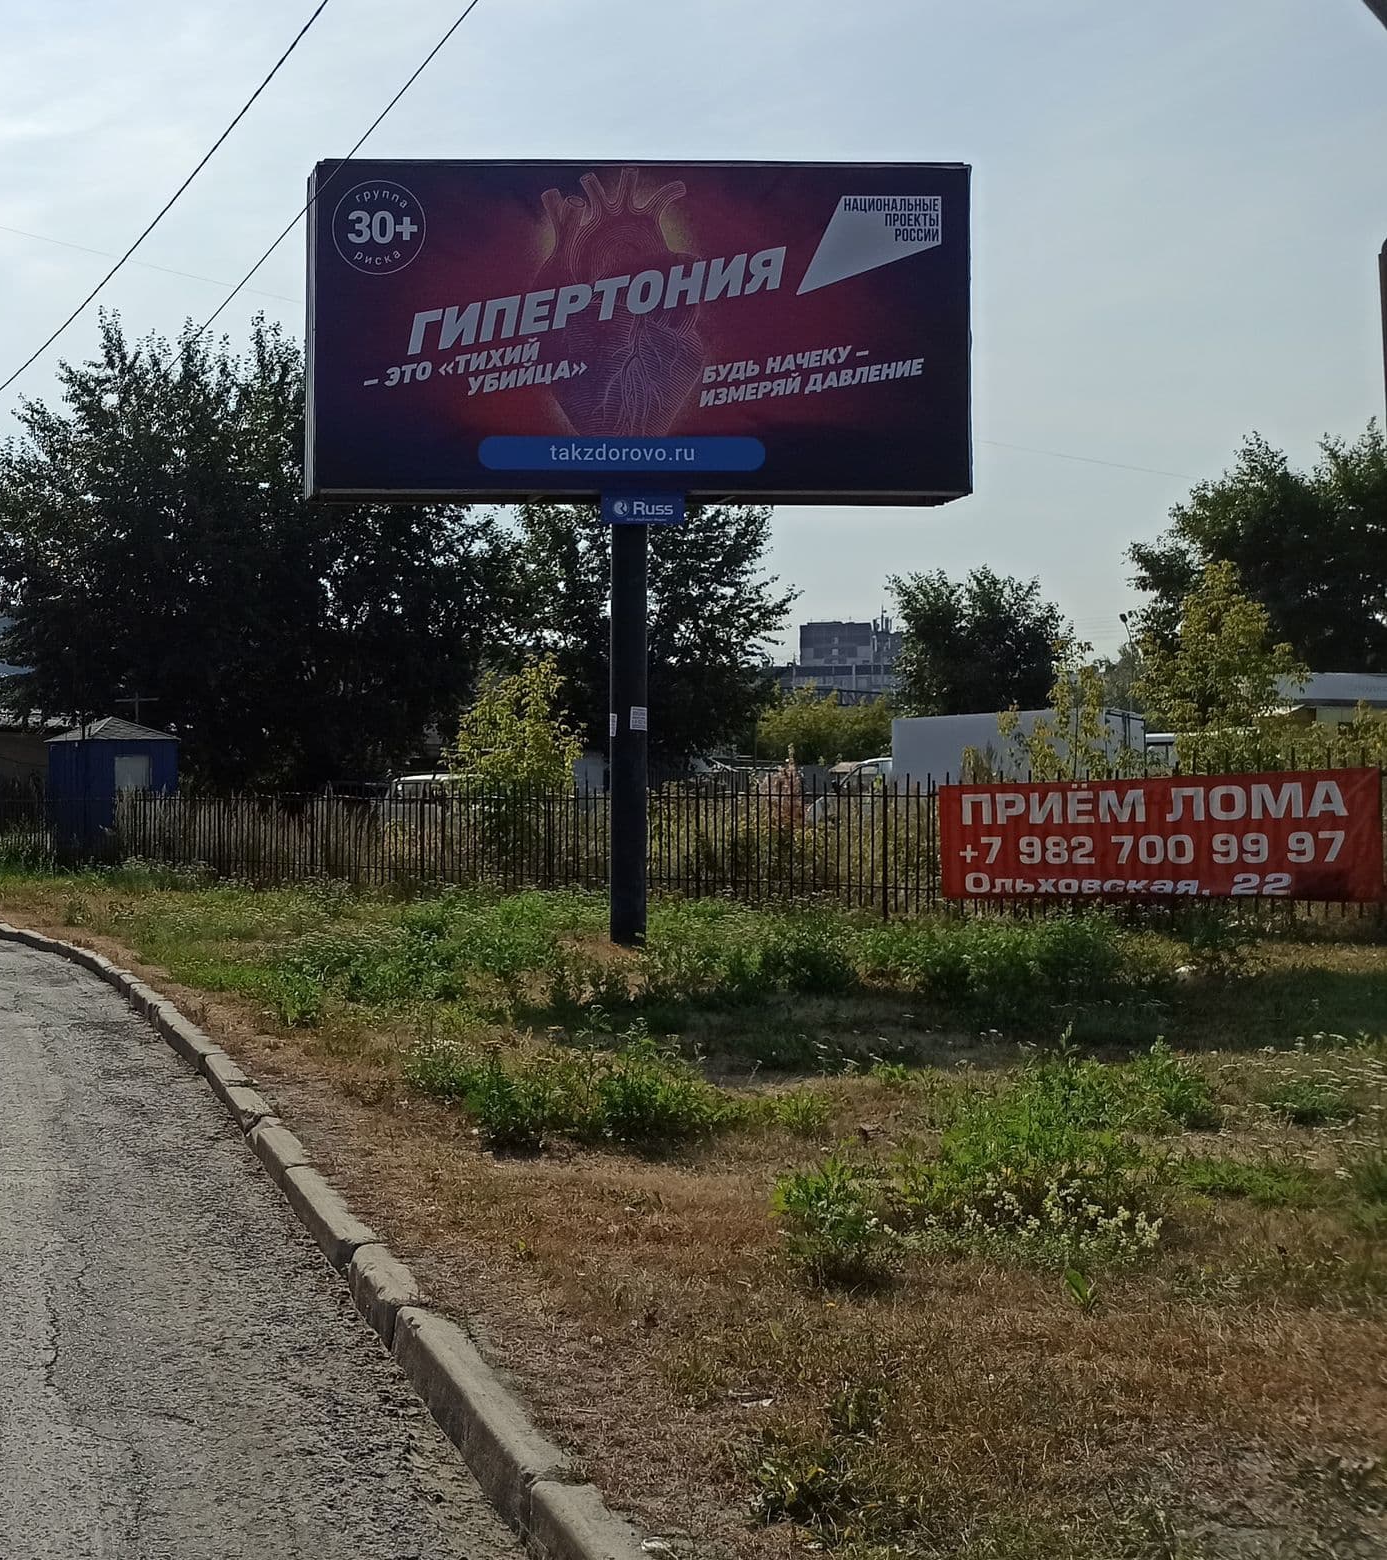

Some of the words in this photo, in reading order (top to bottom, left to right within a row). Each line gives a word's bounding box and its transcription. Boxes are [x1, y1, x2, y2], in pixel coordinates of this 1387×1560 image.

[355, 189, 408, 209] группа
[843, 197, 940, 213] НАЦИОНАЛЬНЫЕ
[347, 210, 418, 244] 30+
[884, 213, 940, 227] ПРОЕКТЫ
[894, 228, 940, 242] РОССИИ
[353, 250, 402, 266] риска
[407, 246, 787, 355] ГИПЕРТОНИЯ
[384, 360, 433, 387] ЭТО
[702, 360, 761, 384] БУДЬ
[765, 345, 852, 374] НАЧЕКУ
[699, 371, 802, 408] ИЗМЕРЯЙ
[805, 358, 925, 396] ДАВЛЕНИЕ
[550, 442, 695, 461] takzdorovo.ru
[633, 501, 674, 516] Russ
[961, 783, 1146, 825] ПРИЁМ
[1166, 781, 1349, 822] ЛОМА
[959, 836, 1002, 865] +7
[1018, 835, 1095, 865] 982
[1111, 834, 1195, 865] 700
[1212, 832, 1269, 864] 99
[1287, 830, 1345, 863] 97
[1230, 872, 1292, 896] 22
